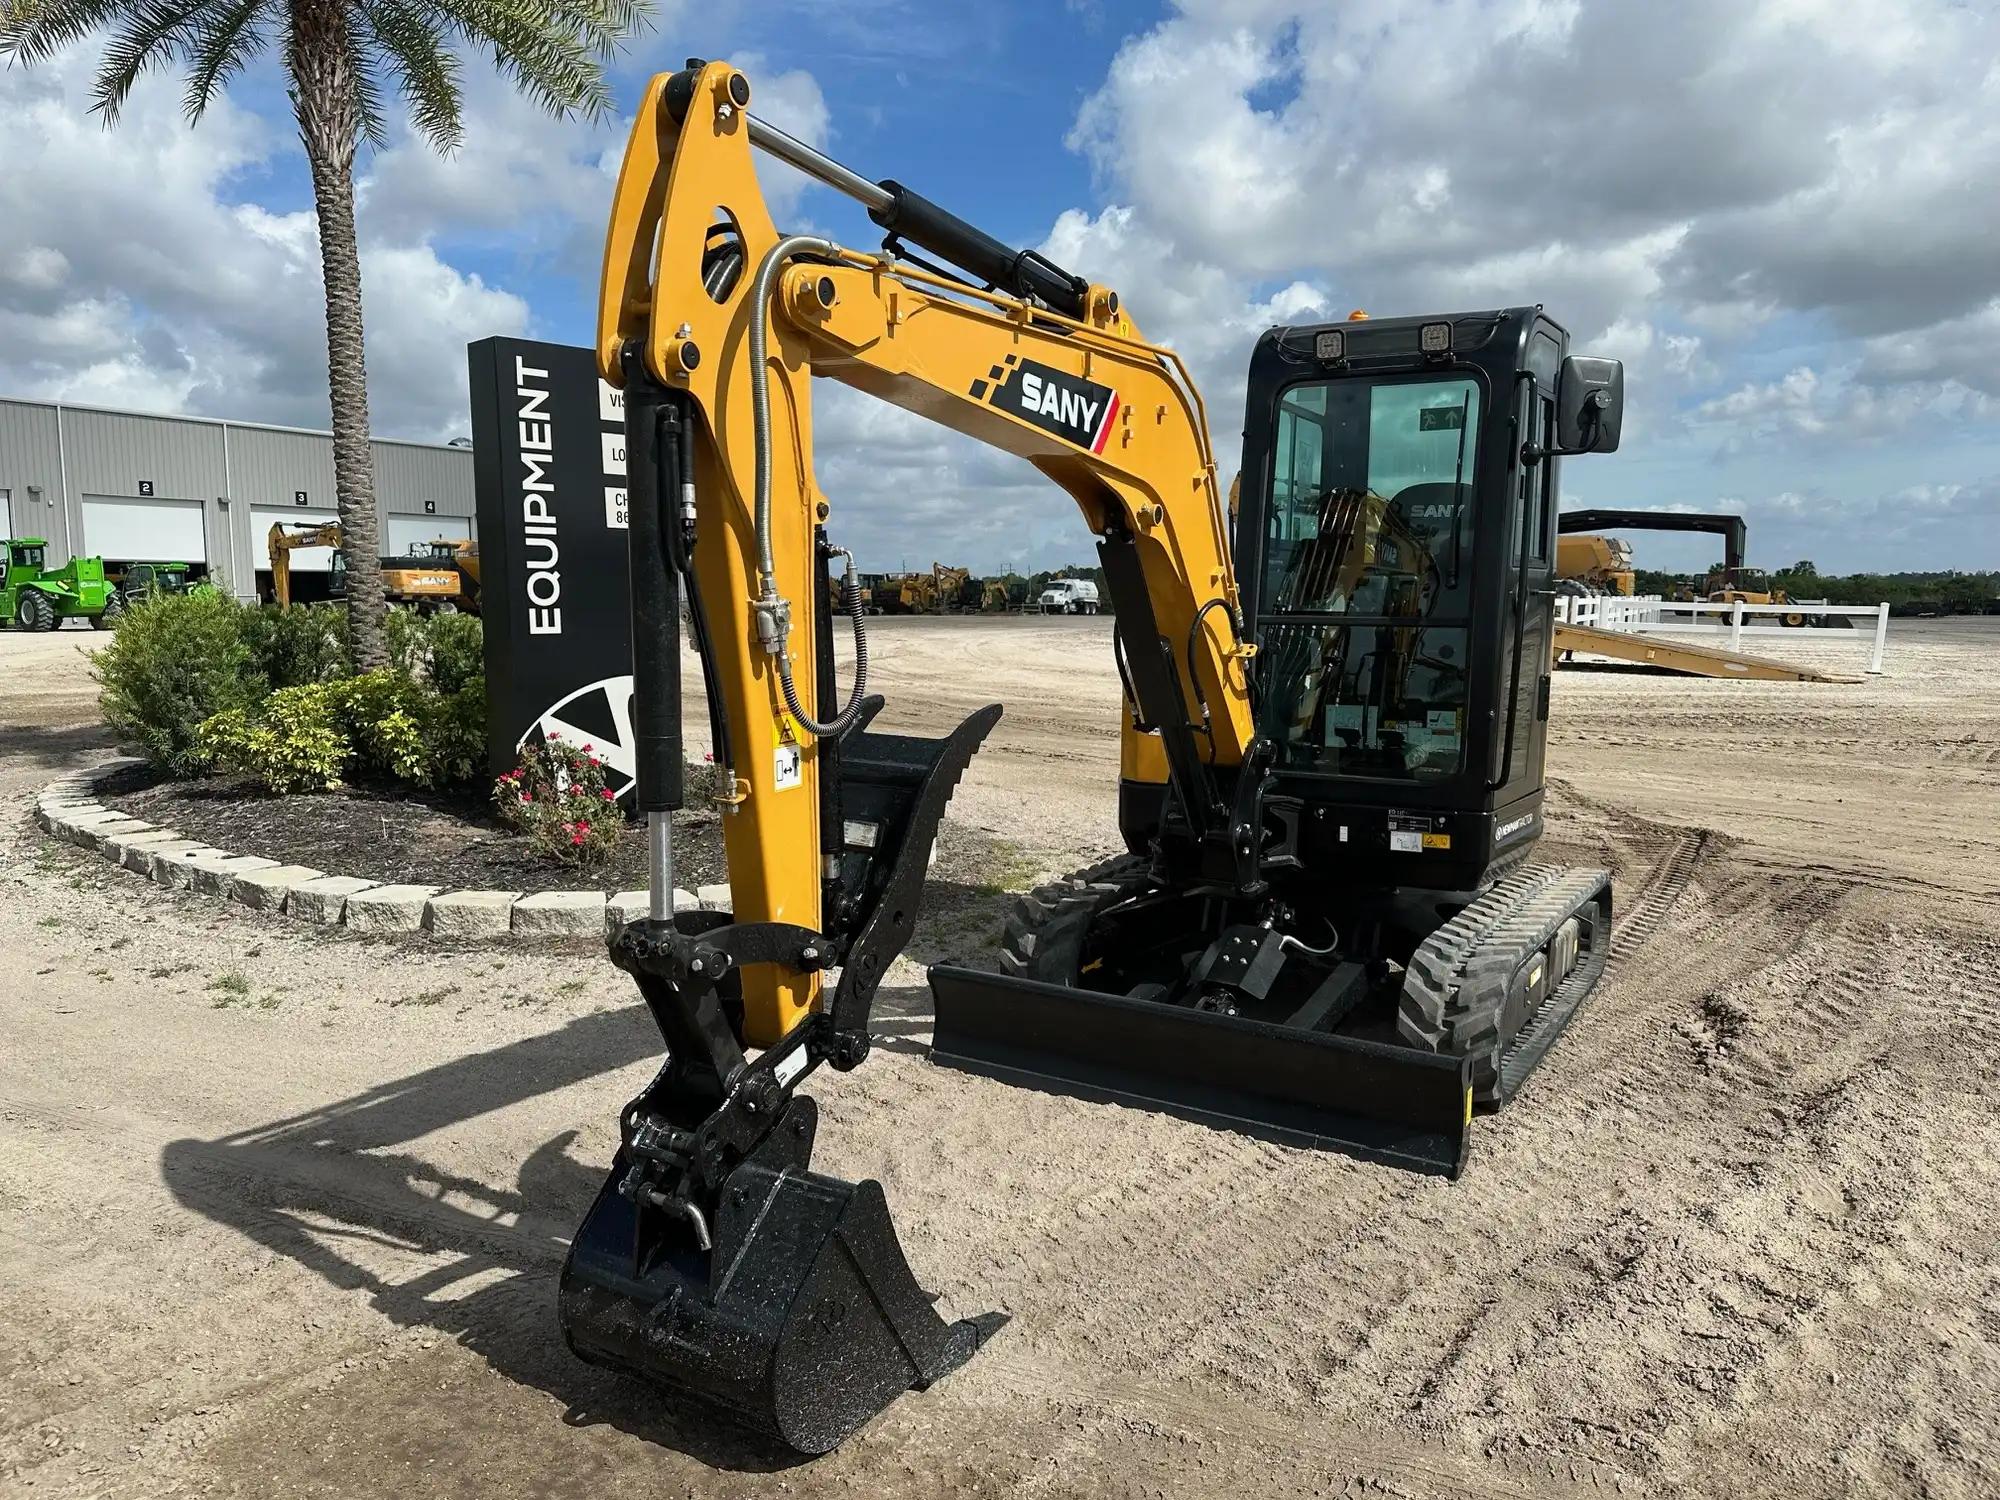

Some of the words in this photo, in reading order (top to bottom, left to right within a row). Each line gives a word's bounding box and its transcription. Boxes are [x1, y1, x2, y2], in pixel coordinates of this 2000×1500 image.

[1021, 372, 1099, 433] SANY
[142, 483, 150, 492] 2
[298, 493, 305, 502] 3
[515, 355, 562, 635] EQUIPMENT
